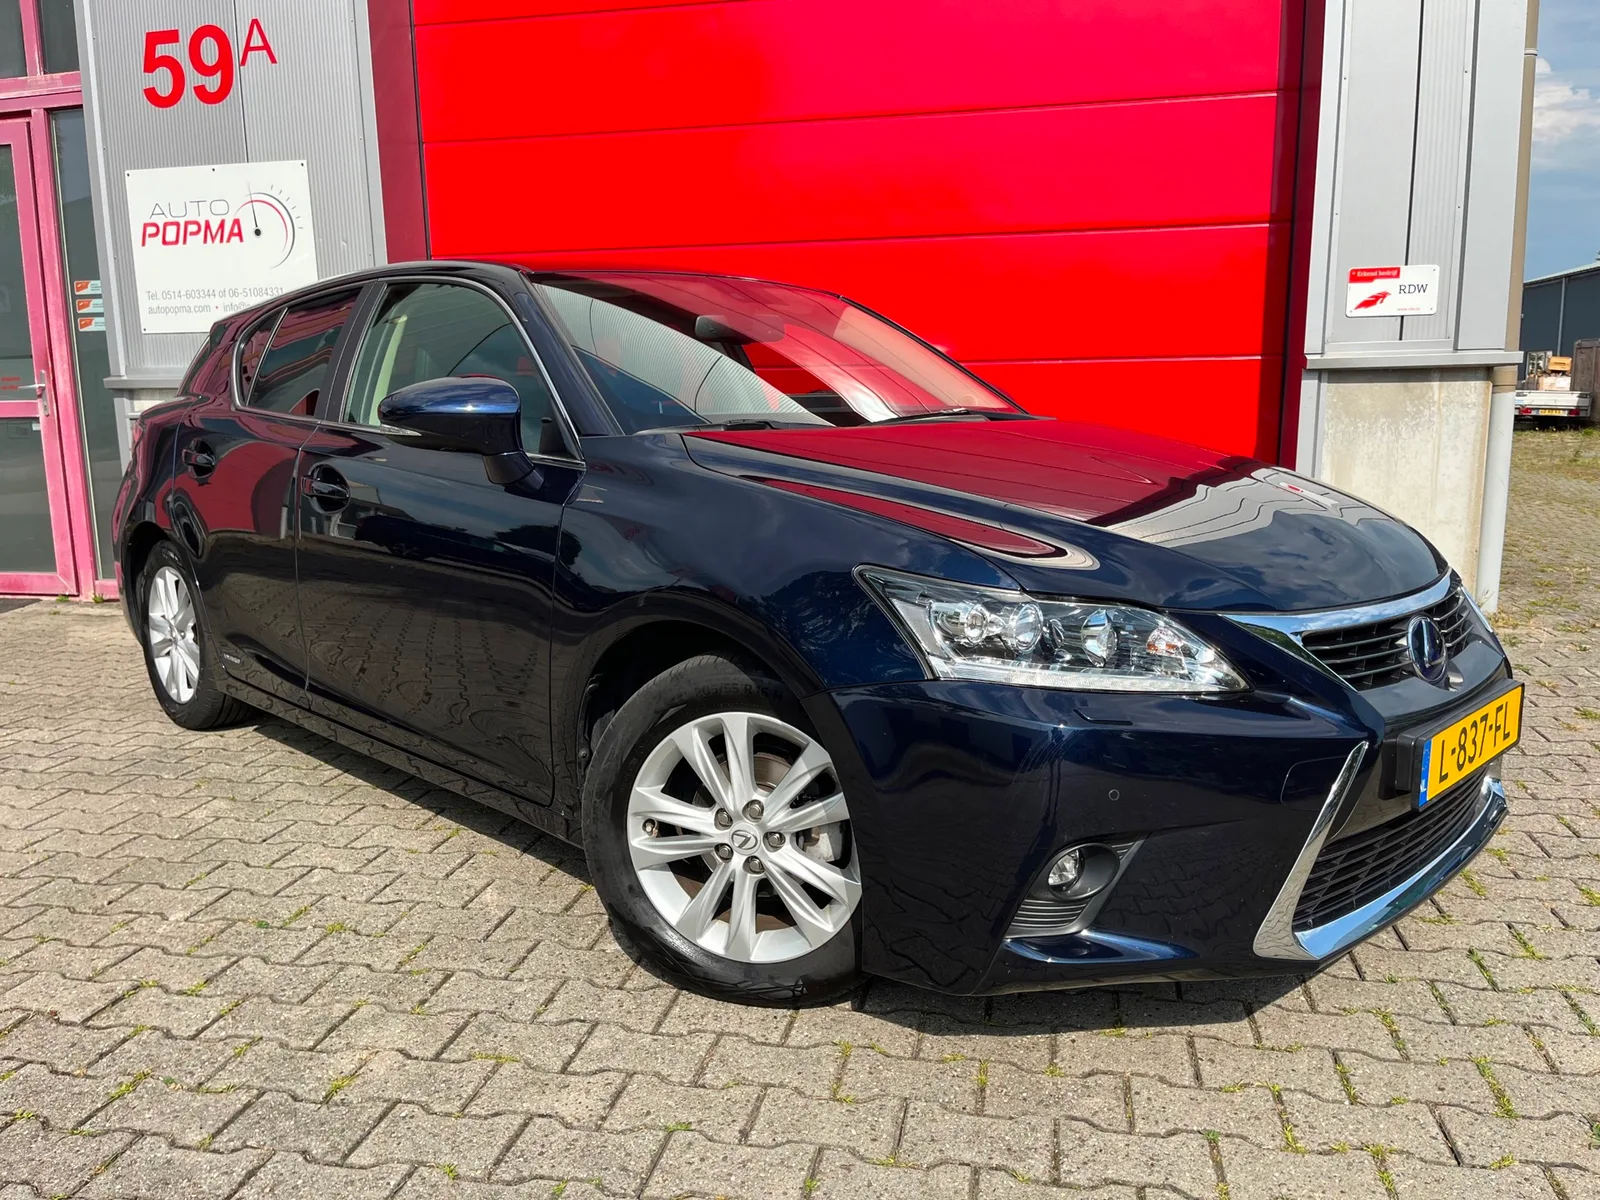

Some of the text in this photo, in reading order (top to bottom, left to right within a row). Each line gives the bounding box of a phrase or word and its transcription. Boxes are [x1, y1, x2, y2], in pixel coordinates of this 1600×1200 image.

[149, 198, 230, 219] AUTO
[141, 218, 244, 247] POPMA
[146, 287, 284, 301] Tel. 0514-603344 of 06-51084331
[1398, 284, 1428, 294] RDW
[148, 304, 211, 316] autopopma.com
[1439, 701, 1511, 784] L-837-FL
